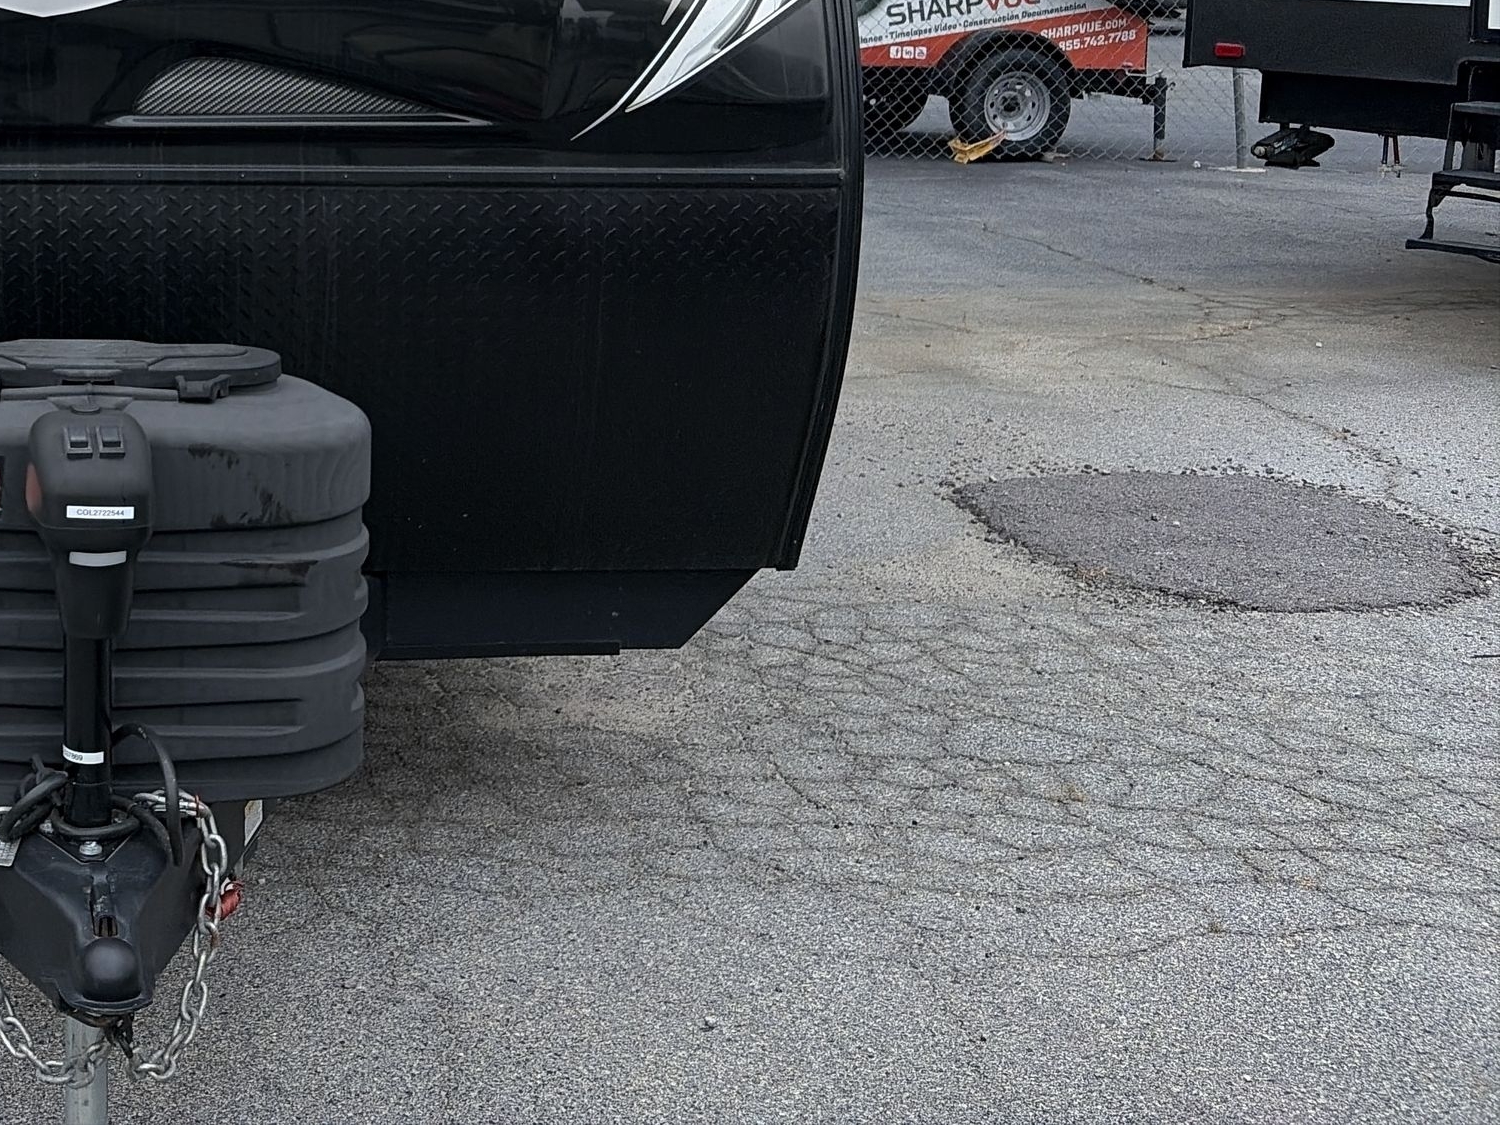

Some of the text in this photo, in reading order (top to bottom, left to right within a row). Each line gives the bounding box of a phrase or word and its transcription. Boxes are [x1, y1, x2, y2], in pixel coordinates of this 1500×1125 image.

[888, 24, 933, 39] Timelapse
[934, 22, 957, 33] Video
[963, 12, 1020, 28] Construction
[1021, 1, 1088, 19] Documentation
[1040, 18, 1127, 39] SHARPVUE.COM
